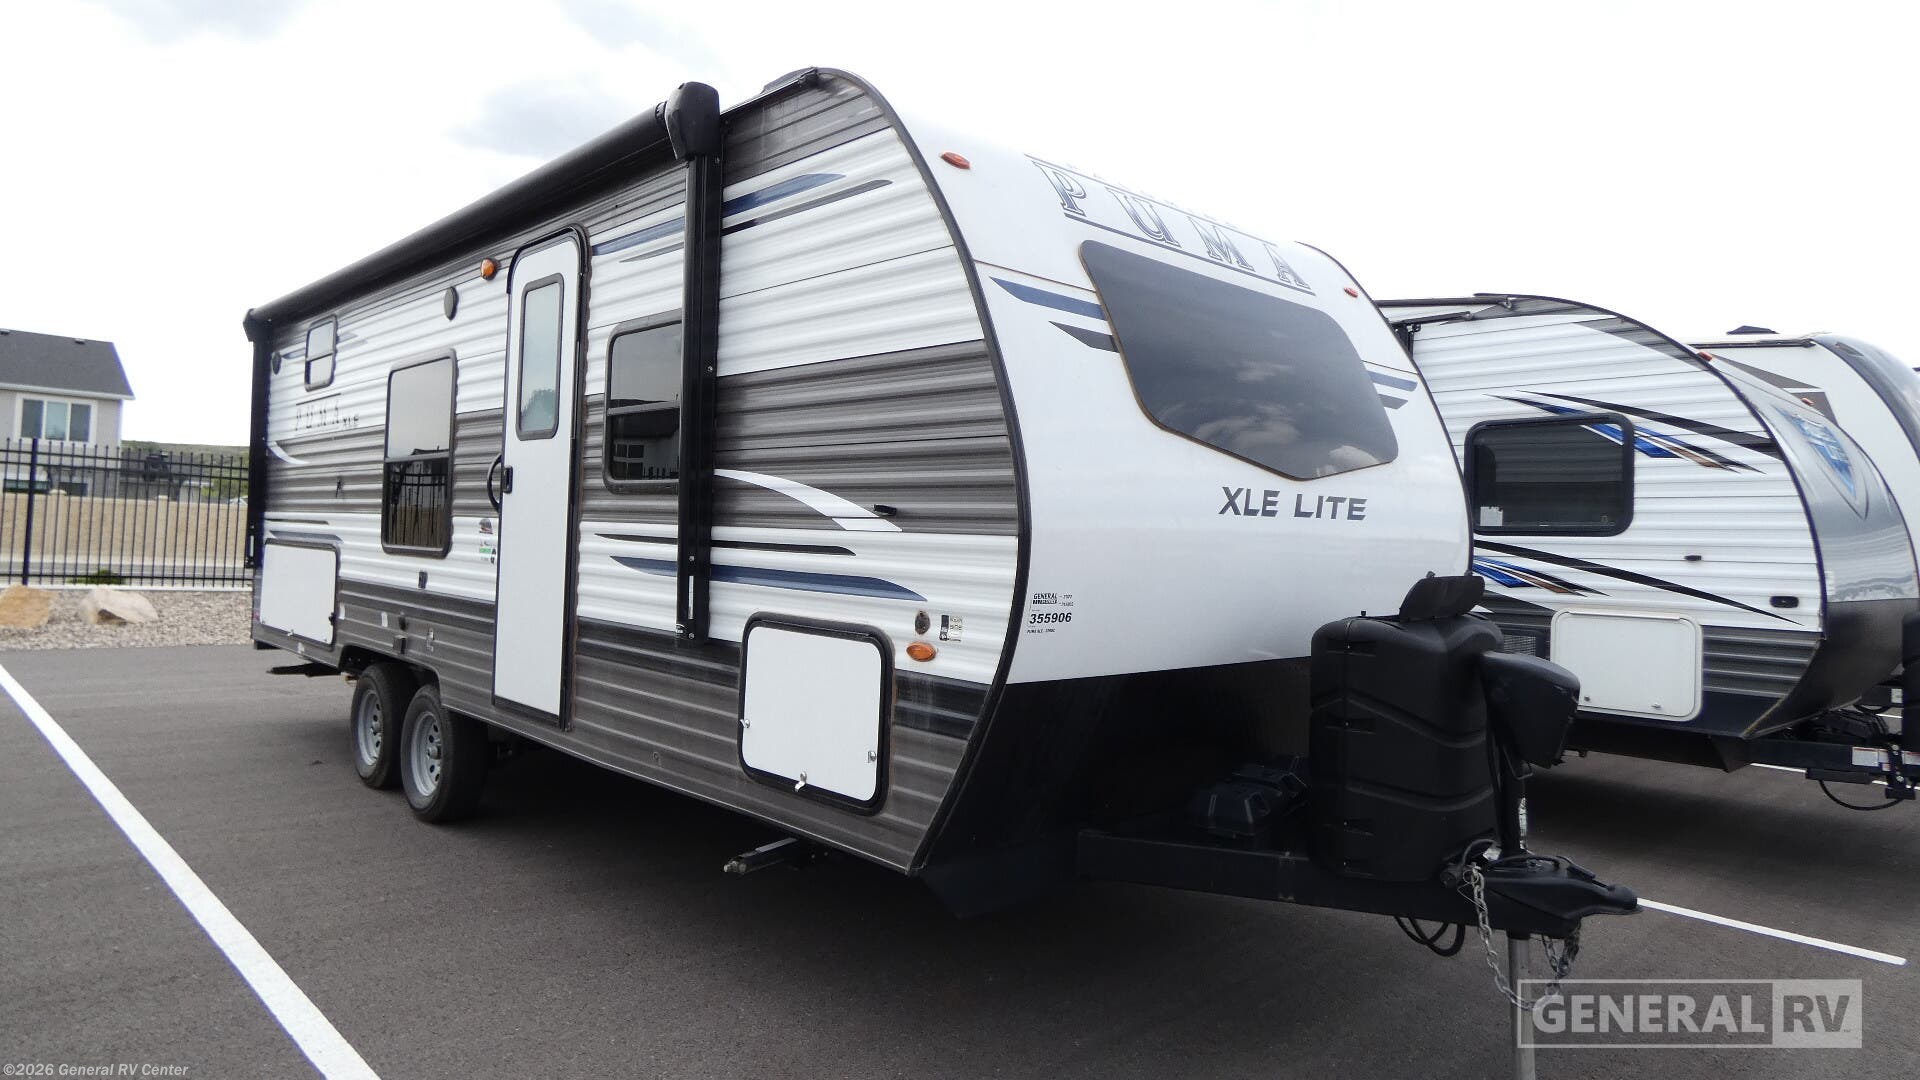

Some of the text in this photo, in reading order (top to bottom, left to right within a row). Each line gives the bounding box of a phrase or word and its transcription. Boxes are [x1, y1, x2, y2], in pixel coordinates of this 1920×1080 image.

[1031, 160, 1312, 290] PUMA
[1218, 486, 1368, 521] XLE LITE
[1033, 592, 1058, 600] GENERAL
[1029, 612, 1072, 624] 355906
